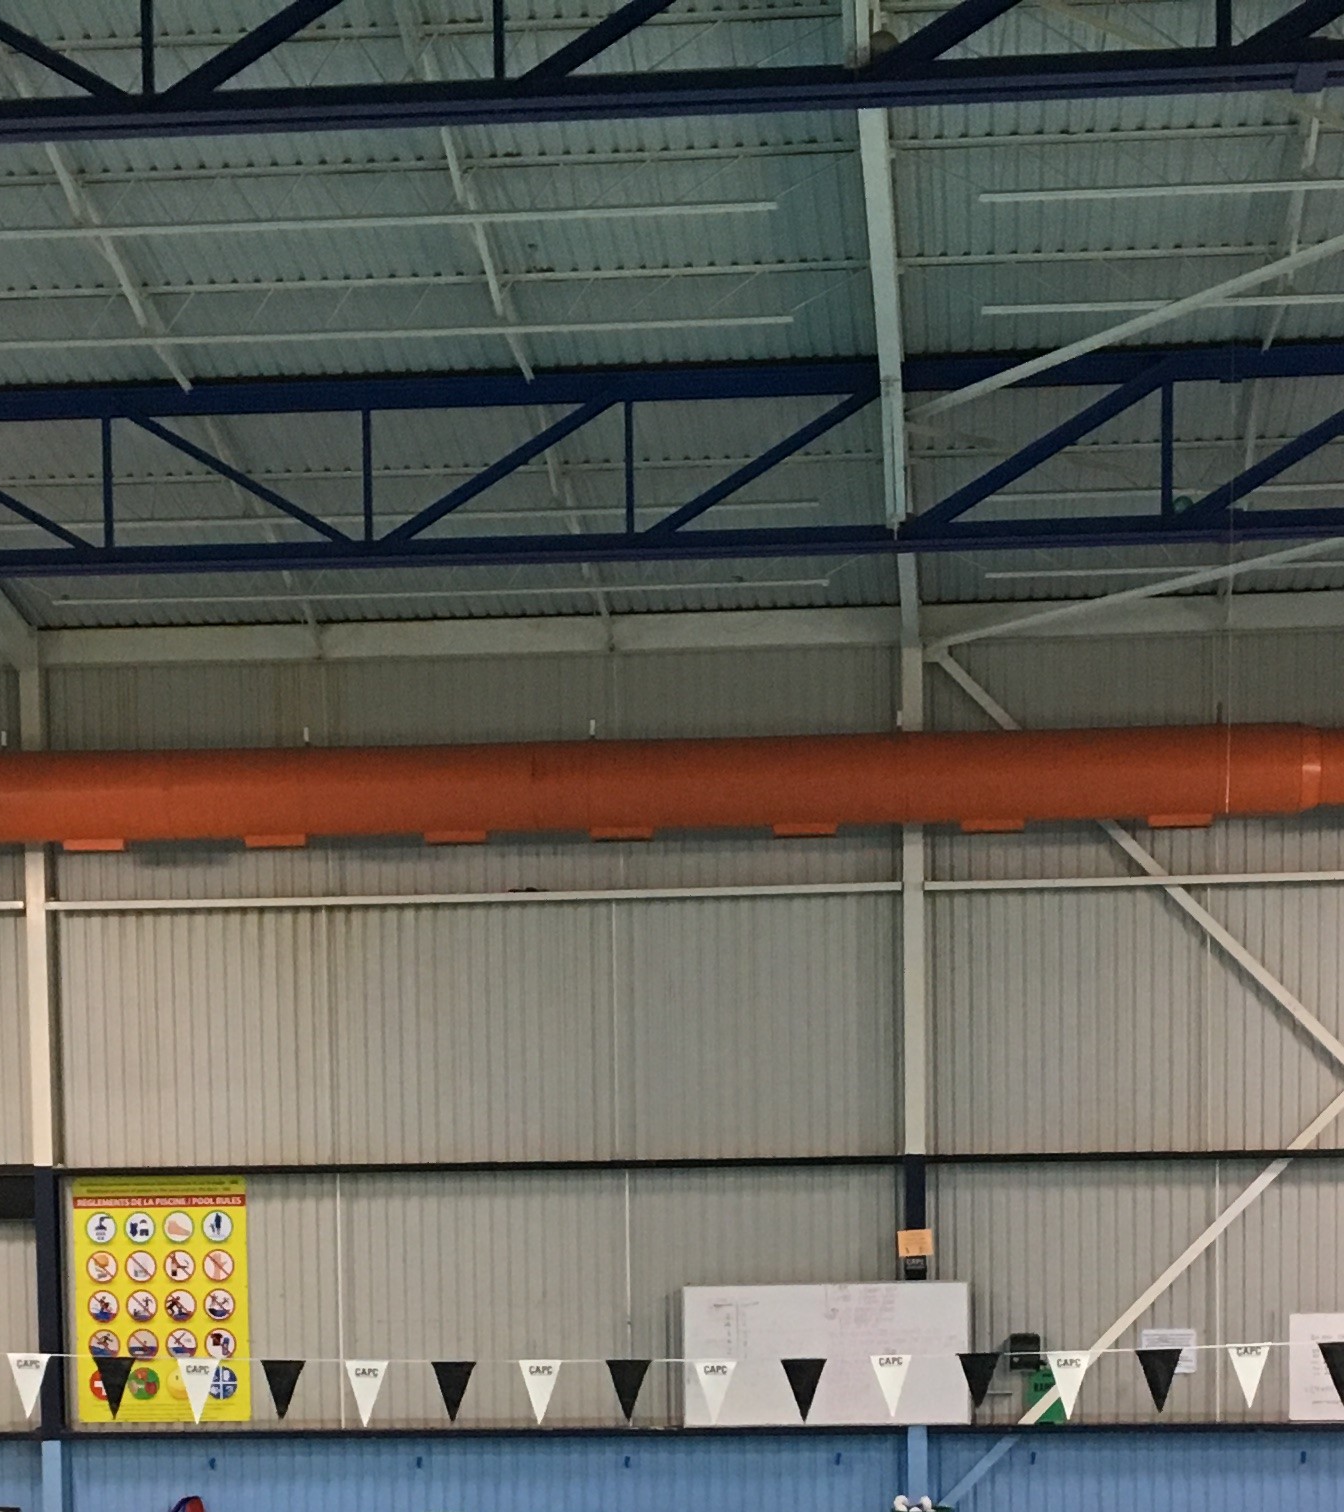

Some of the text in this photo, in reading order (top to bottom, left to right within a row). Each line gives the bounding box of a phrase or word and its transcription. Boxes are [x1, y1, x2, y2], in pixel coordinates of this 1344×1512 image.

[131, 1198, 143, 1206] DE
[143, 1198, 155, 1206] LA
[192, 1197, 215, 1205] POOL
[216, 1196, 242, 1204] RULES
[1236, 1346, 1261, 1357] CAPC
[16, 1359, 40, 1369] CAPC
[879, 1357, 903, 1367] CAPC
[1057, 1358, 1081, 1368] CAPC
[186, 1365, 210, 1375] CAPC
[355, 1368, 379, 1377] CAPC
[529, 1365, 552, 1375] CAPC
[703, 1365, 727, 1375] CAPC
